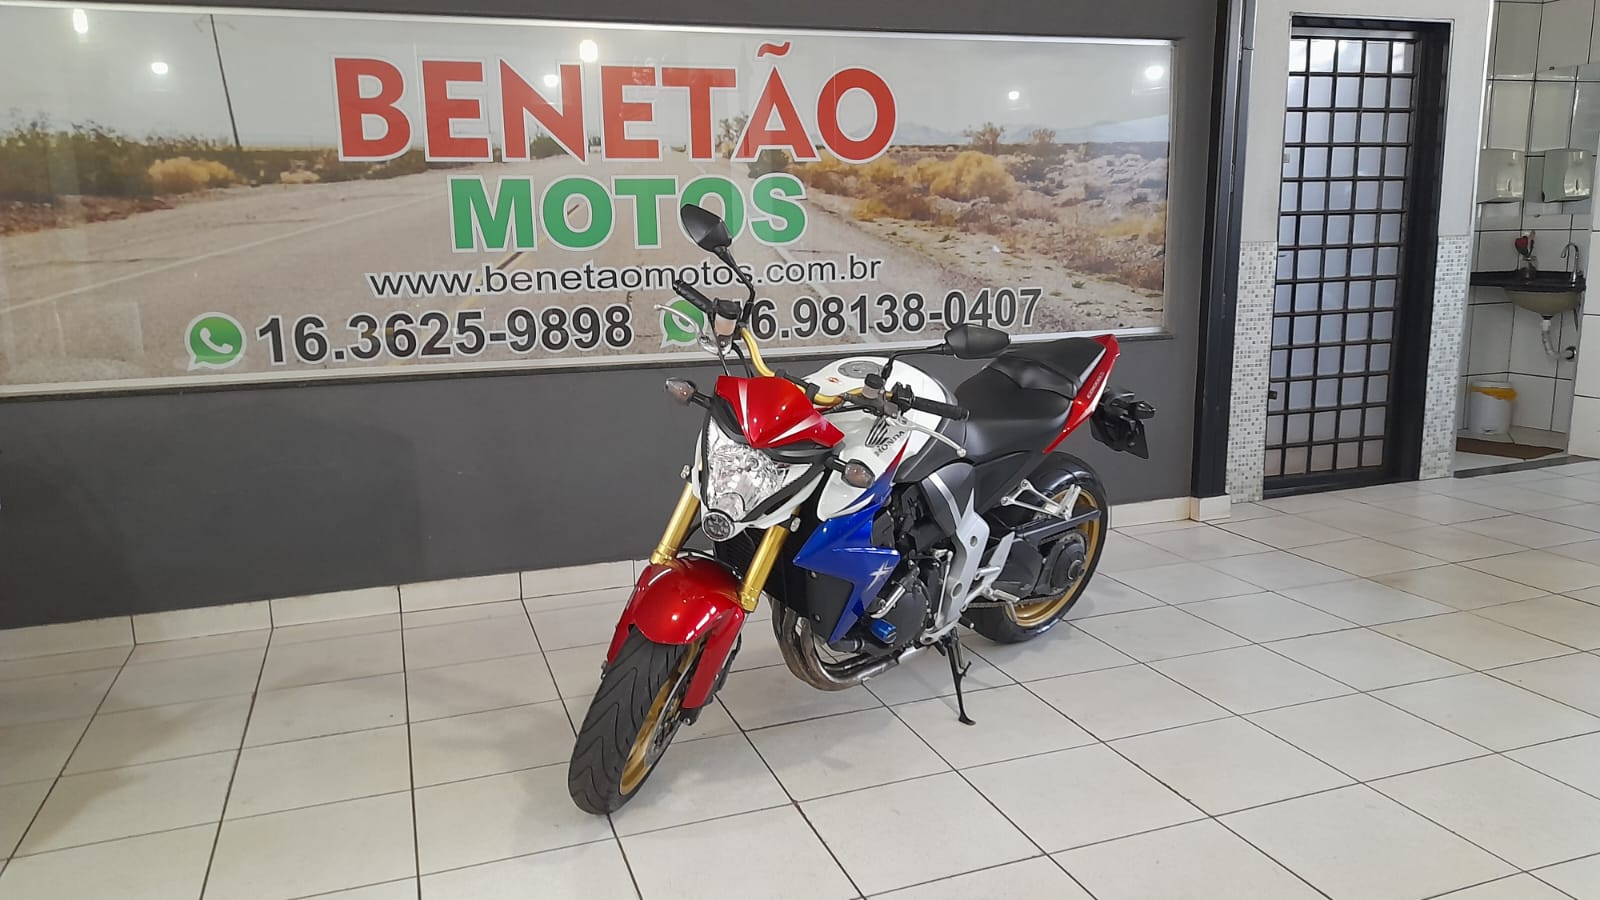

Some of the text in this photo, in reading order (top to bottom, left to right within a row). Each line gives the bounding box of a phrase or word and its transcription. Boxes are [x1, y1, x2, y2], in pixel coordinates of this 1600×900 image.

[332, 41, 897, 163] BENETÃO
[450, 175, 807, 250] MOTOS
[369, 255, 881, 296] www.benetaomotos.com.br
[257, 306, 632, 363] 16.3625-9898
[724, 287, 1042, 341] 6.98138-0407
[873, 430, 905, 457] HONDA
